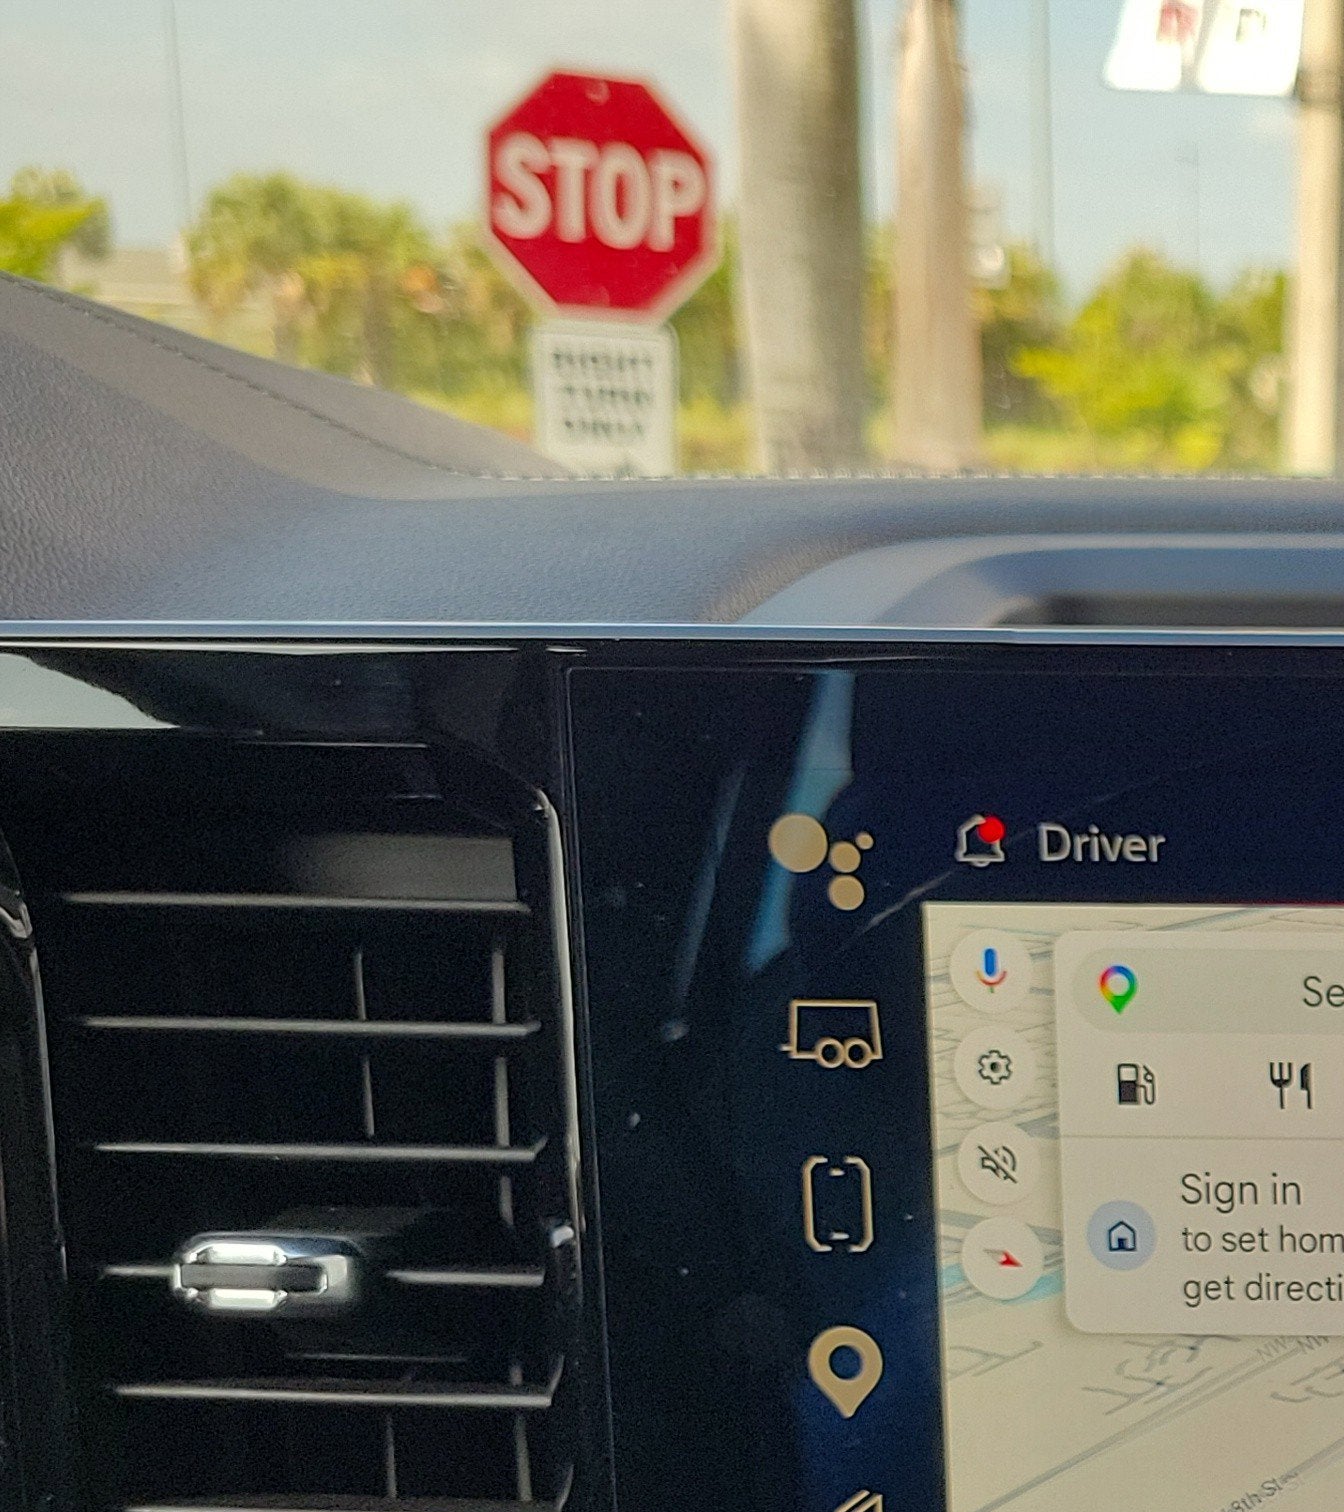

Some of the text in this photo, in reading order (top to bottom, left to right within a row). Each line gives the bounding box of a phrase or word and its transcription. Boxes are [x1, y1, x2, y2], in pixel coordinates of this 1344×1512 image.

[489, 130, 708, 253] STOP
[1038, 823, 1166, 863] Driver
[1181, 1171, 1302, 1214] Sign in
[1181, 1227, 1212, 1253] to
[1222, 1227, 1270, 1253] set
[1183, 1276, 1235, 1308] get
[1261, 1477, 1283, 1497] St
